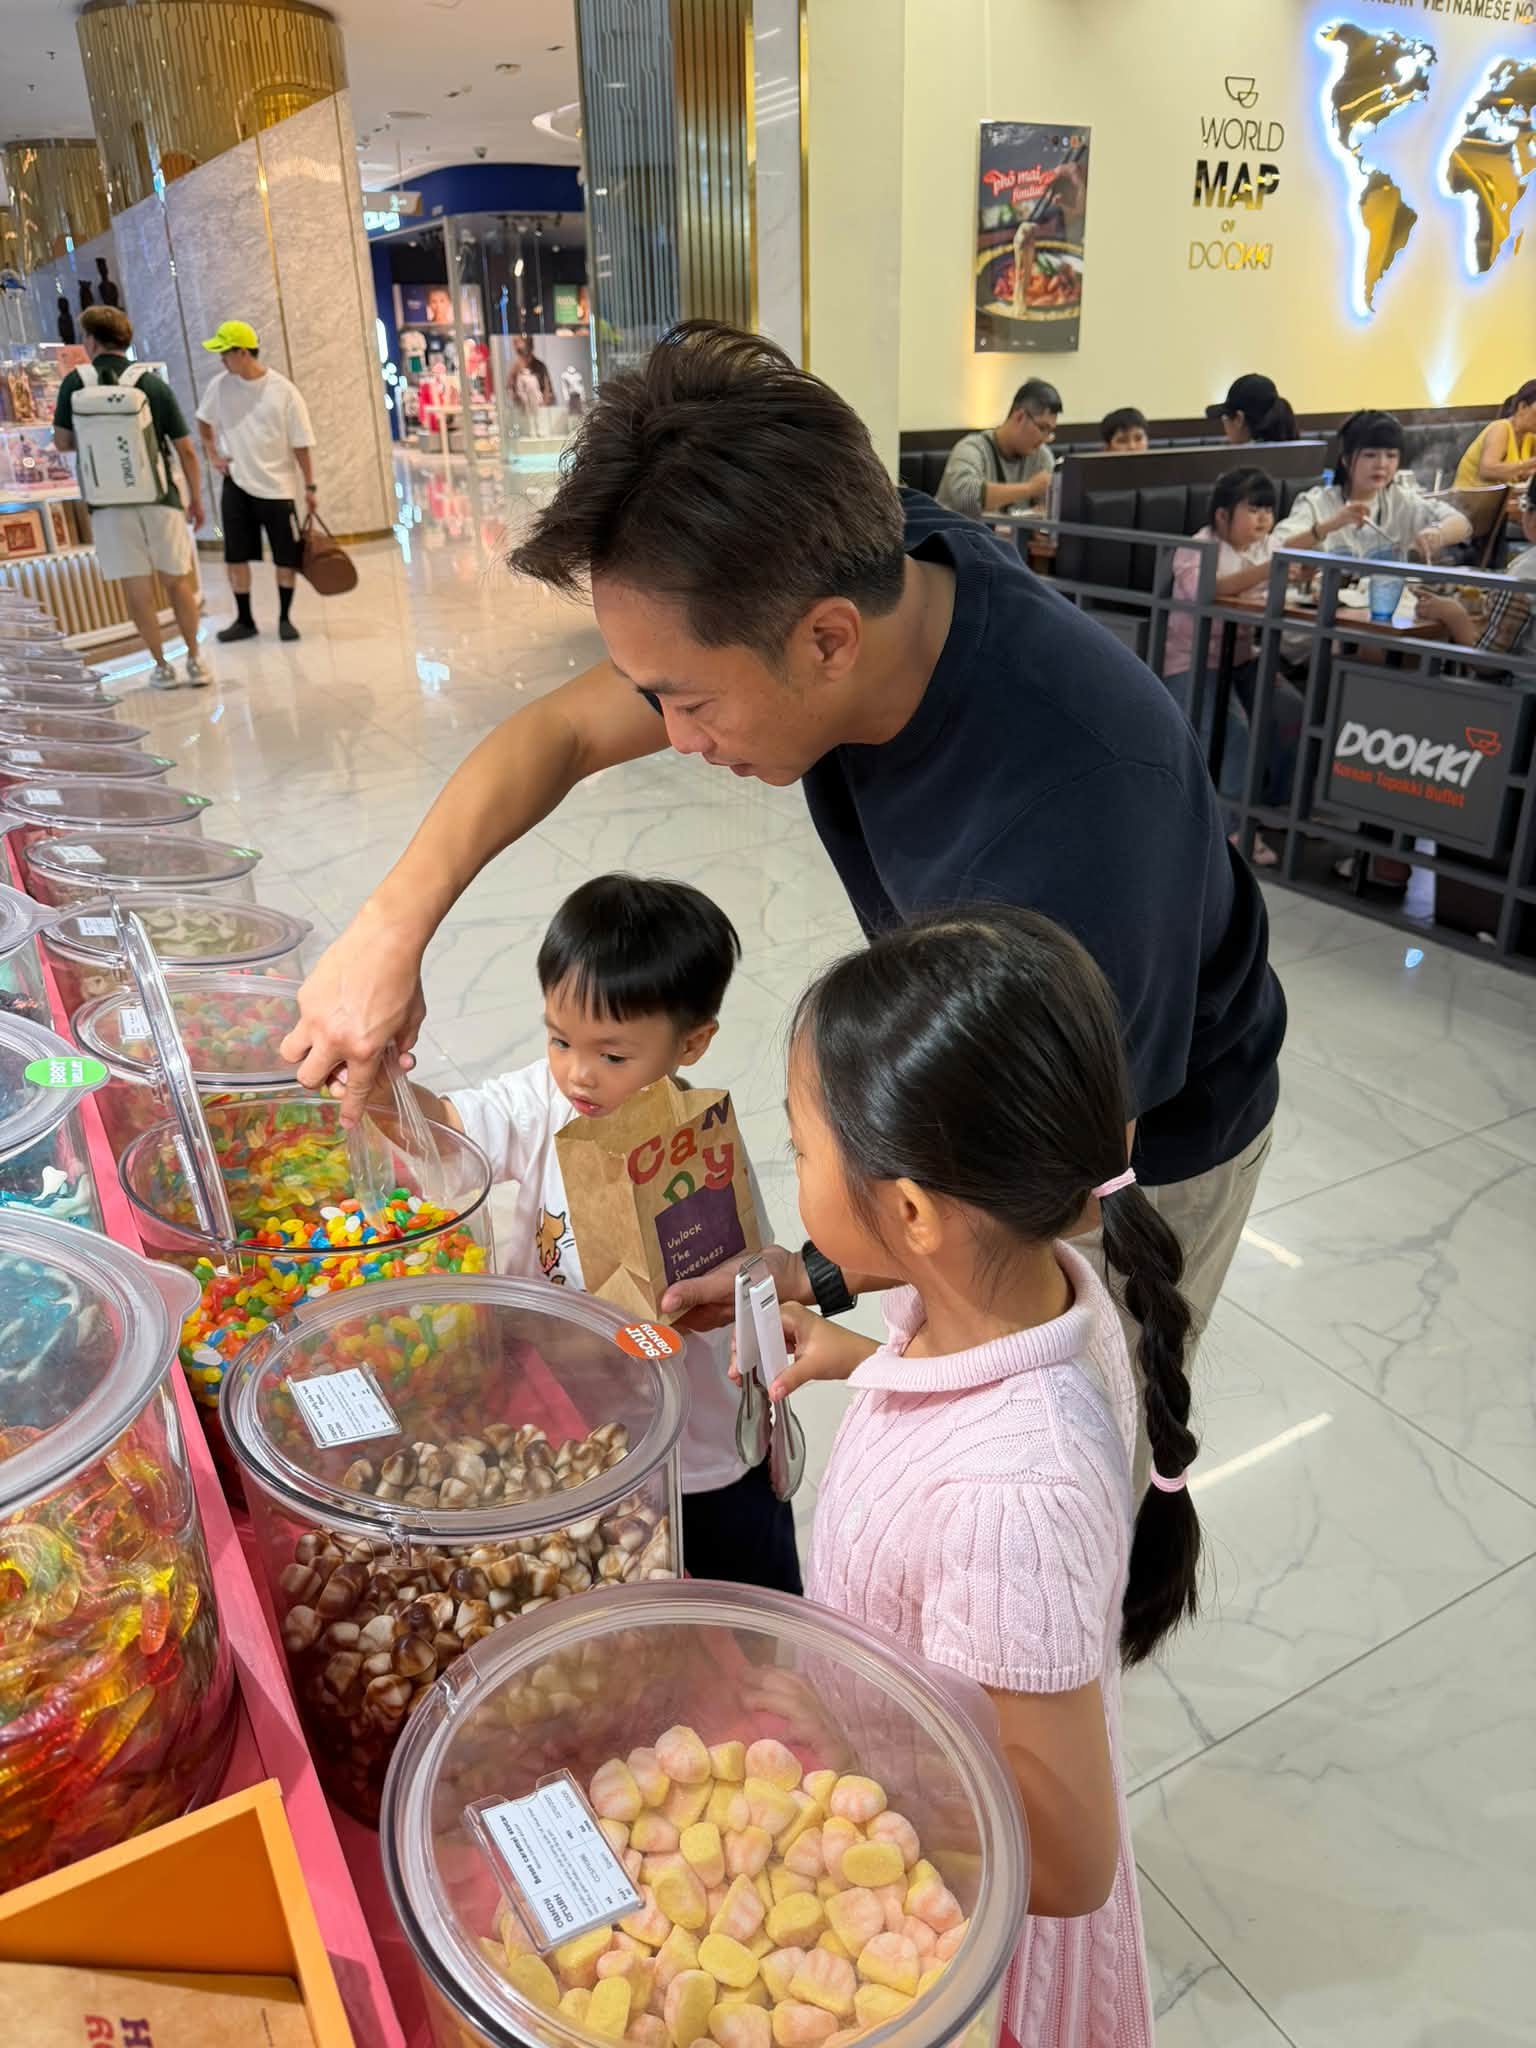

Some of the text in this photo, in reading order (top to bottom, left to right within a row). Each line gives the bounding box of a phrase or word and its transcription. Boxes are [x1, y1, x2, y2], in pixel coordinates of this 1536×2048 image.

[1200, 116, 1285, 152] WORLD
[1192, 159, 1281, 210] MAP
[1335, 720, 1484, 788] DOOKKI
[667, 1223, 703, 1249] Unlock
[671, 1249, 691, 1265] The
[675, 1245, 725, 1281] Sweetness
